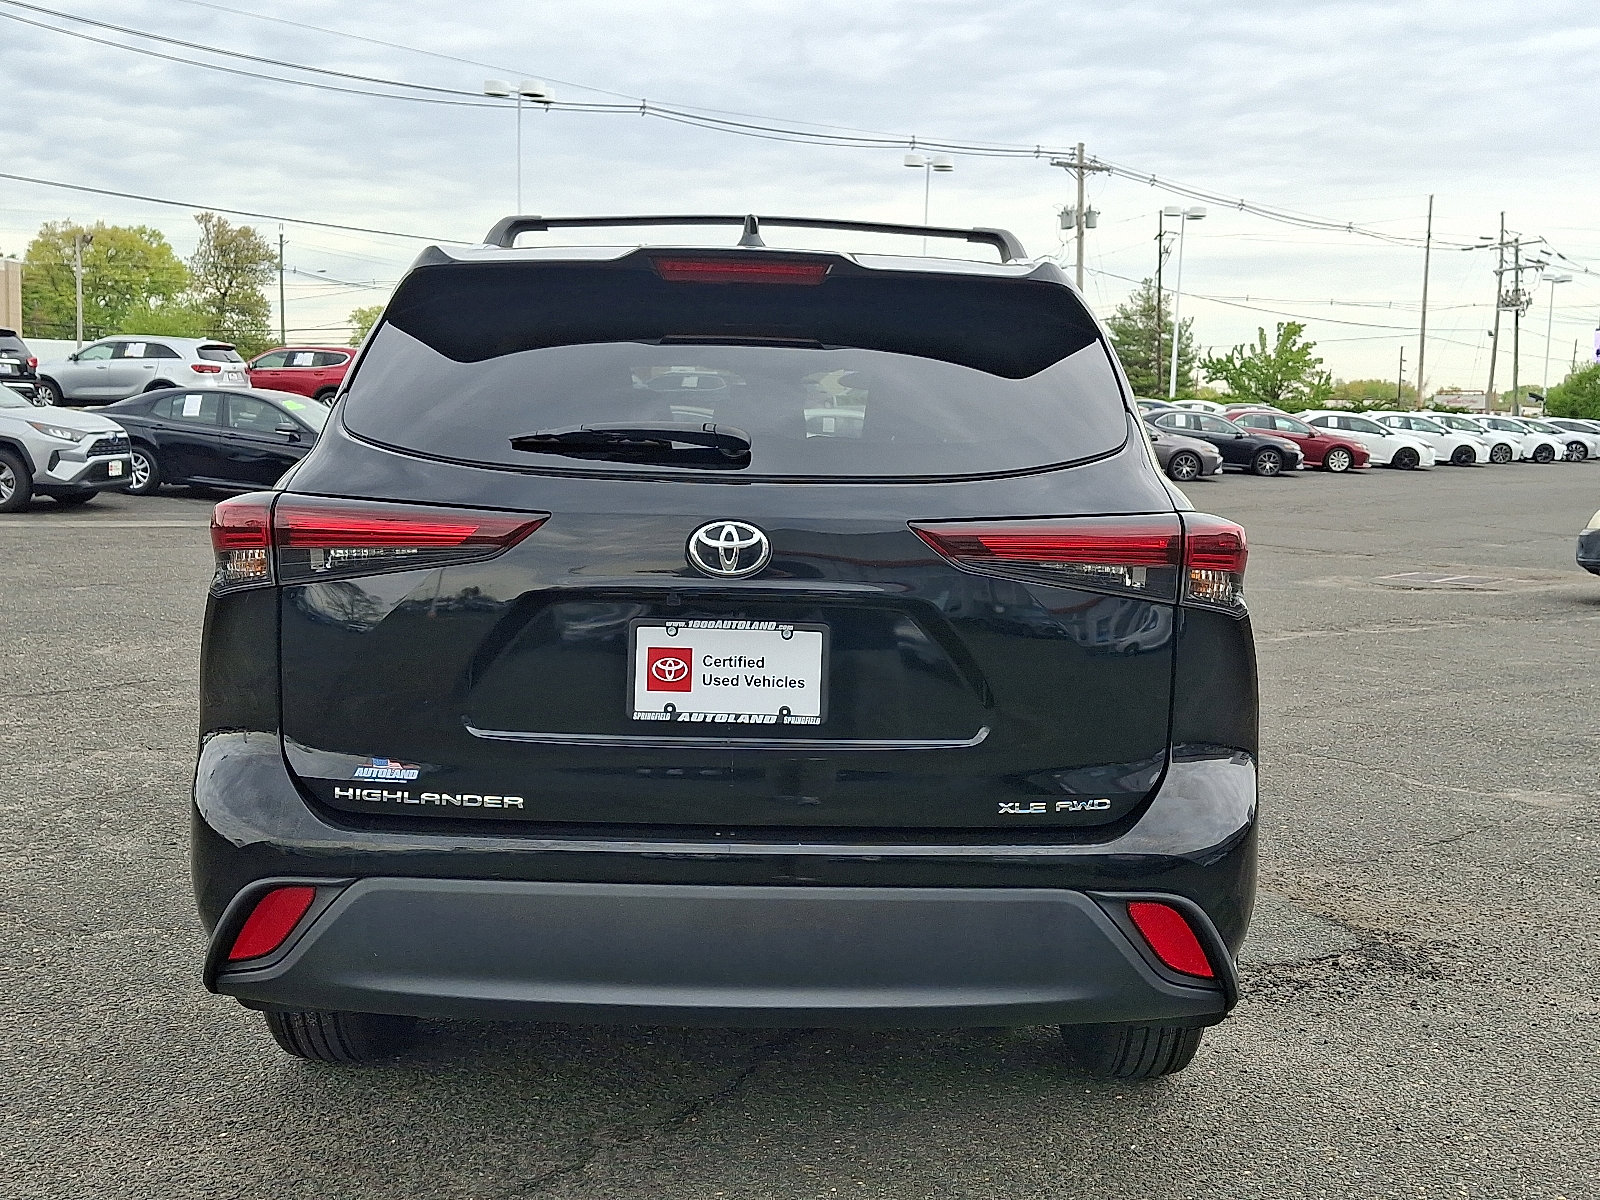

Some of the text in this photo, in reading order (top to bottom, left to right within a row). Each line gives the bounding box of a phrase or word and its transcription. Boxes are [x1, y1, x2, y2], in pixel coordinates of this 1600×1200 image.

[702, 654, 765, 669] Certified
[702, 674, 805, 689] Used Vehicles
[633, 711, 821, 725] SPRINGFIELD AUTOLAND SPRINGFIELD
[354, 767, 419, 780] AUTOLAND
[334, 786, 524, 809] HIGHLANDER
[998, 798, 1111, 814] XLE AWD
